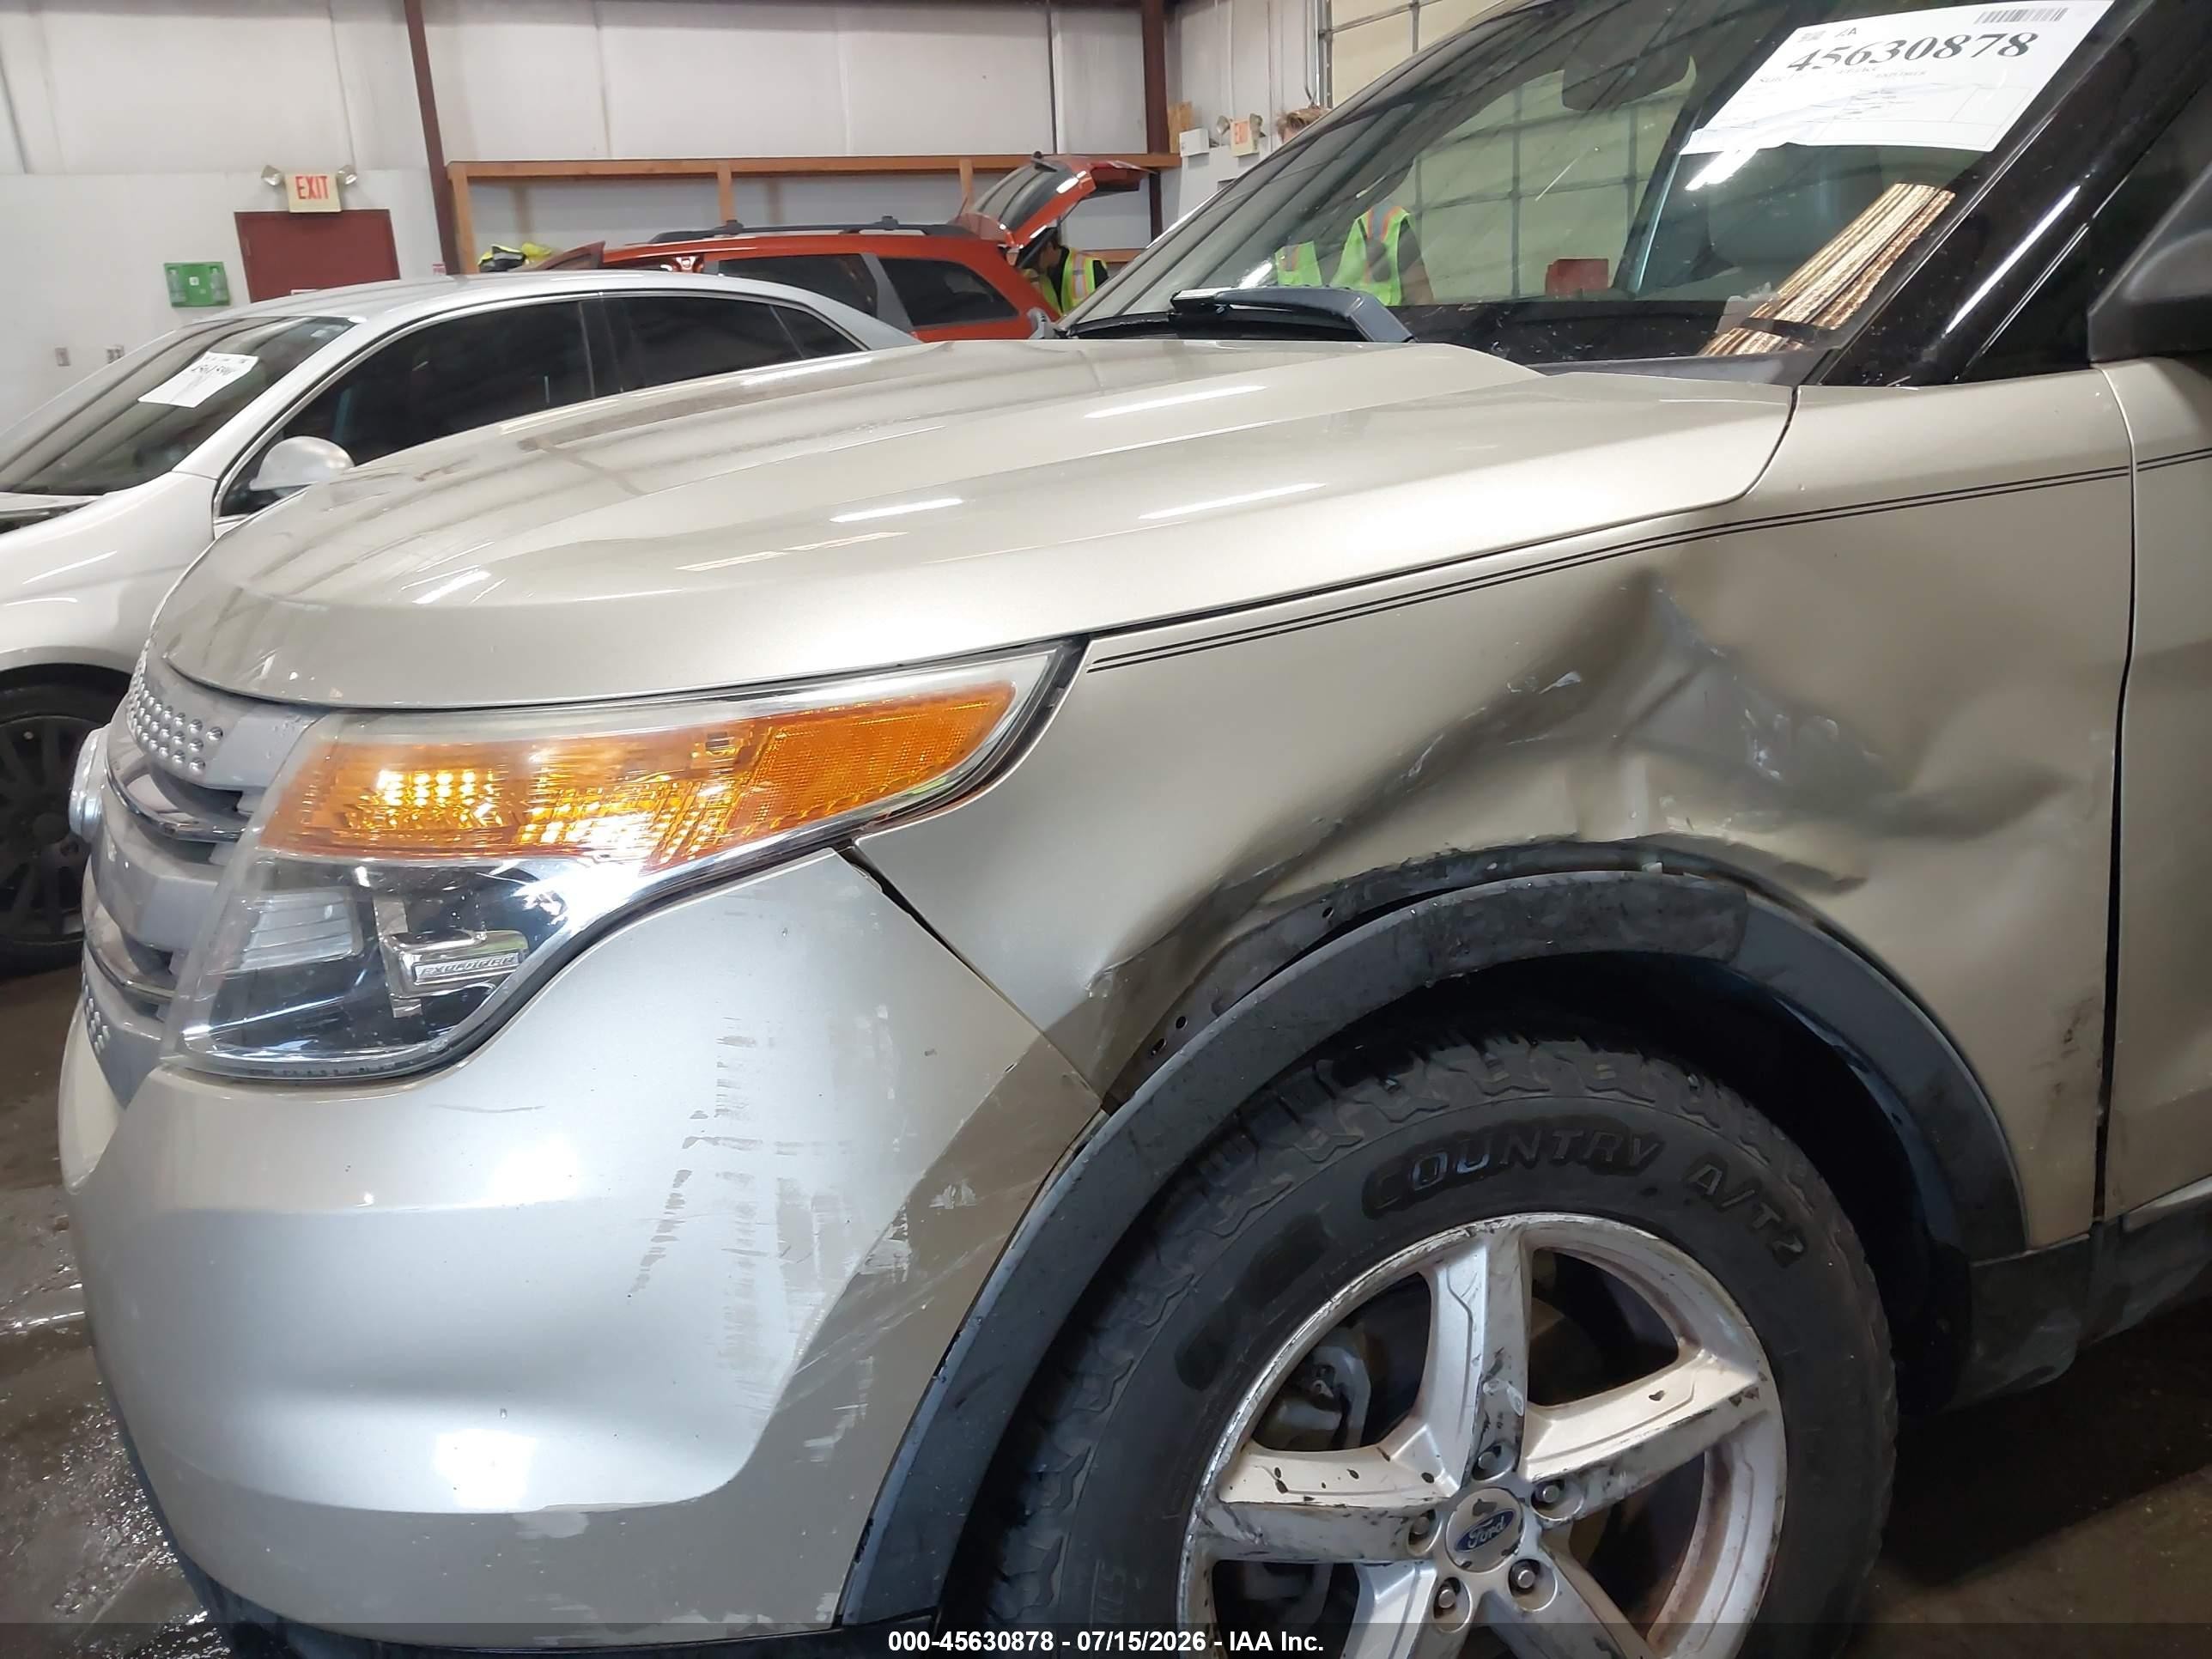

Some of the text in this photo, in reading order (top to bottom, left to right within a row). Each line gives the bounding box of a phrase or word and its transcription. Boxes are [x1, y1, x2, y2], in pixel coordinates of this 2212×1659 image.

[1786, 32, 2040, 71] 45630878
[295, 175, 330, 200] EXIT
[1376, 1128, 1664, 1210] COUNTRY
[1467, 1515, 1505, 1549] Ford
